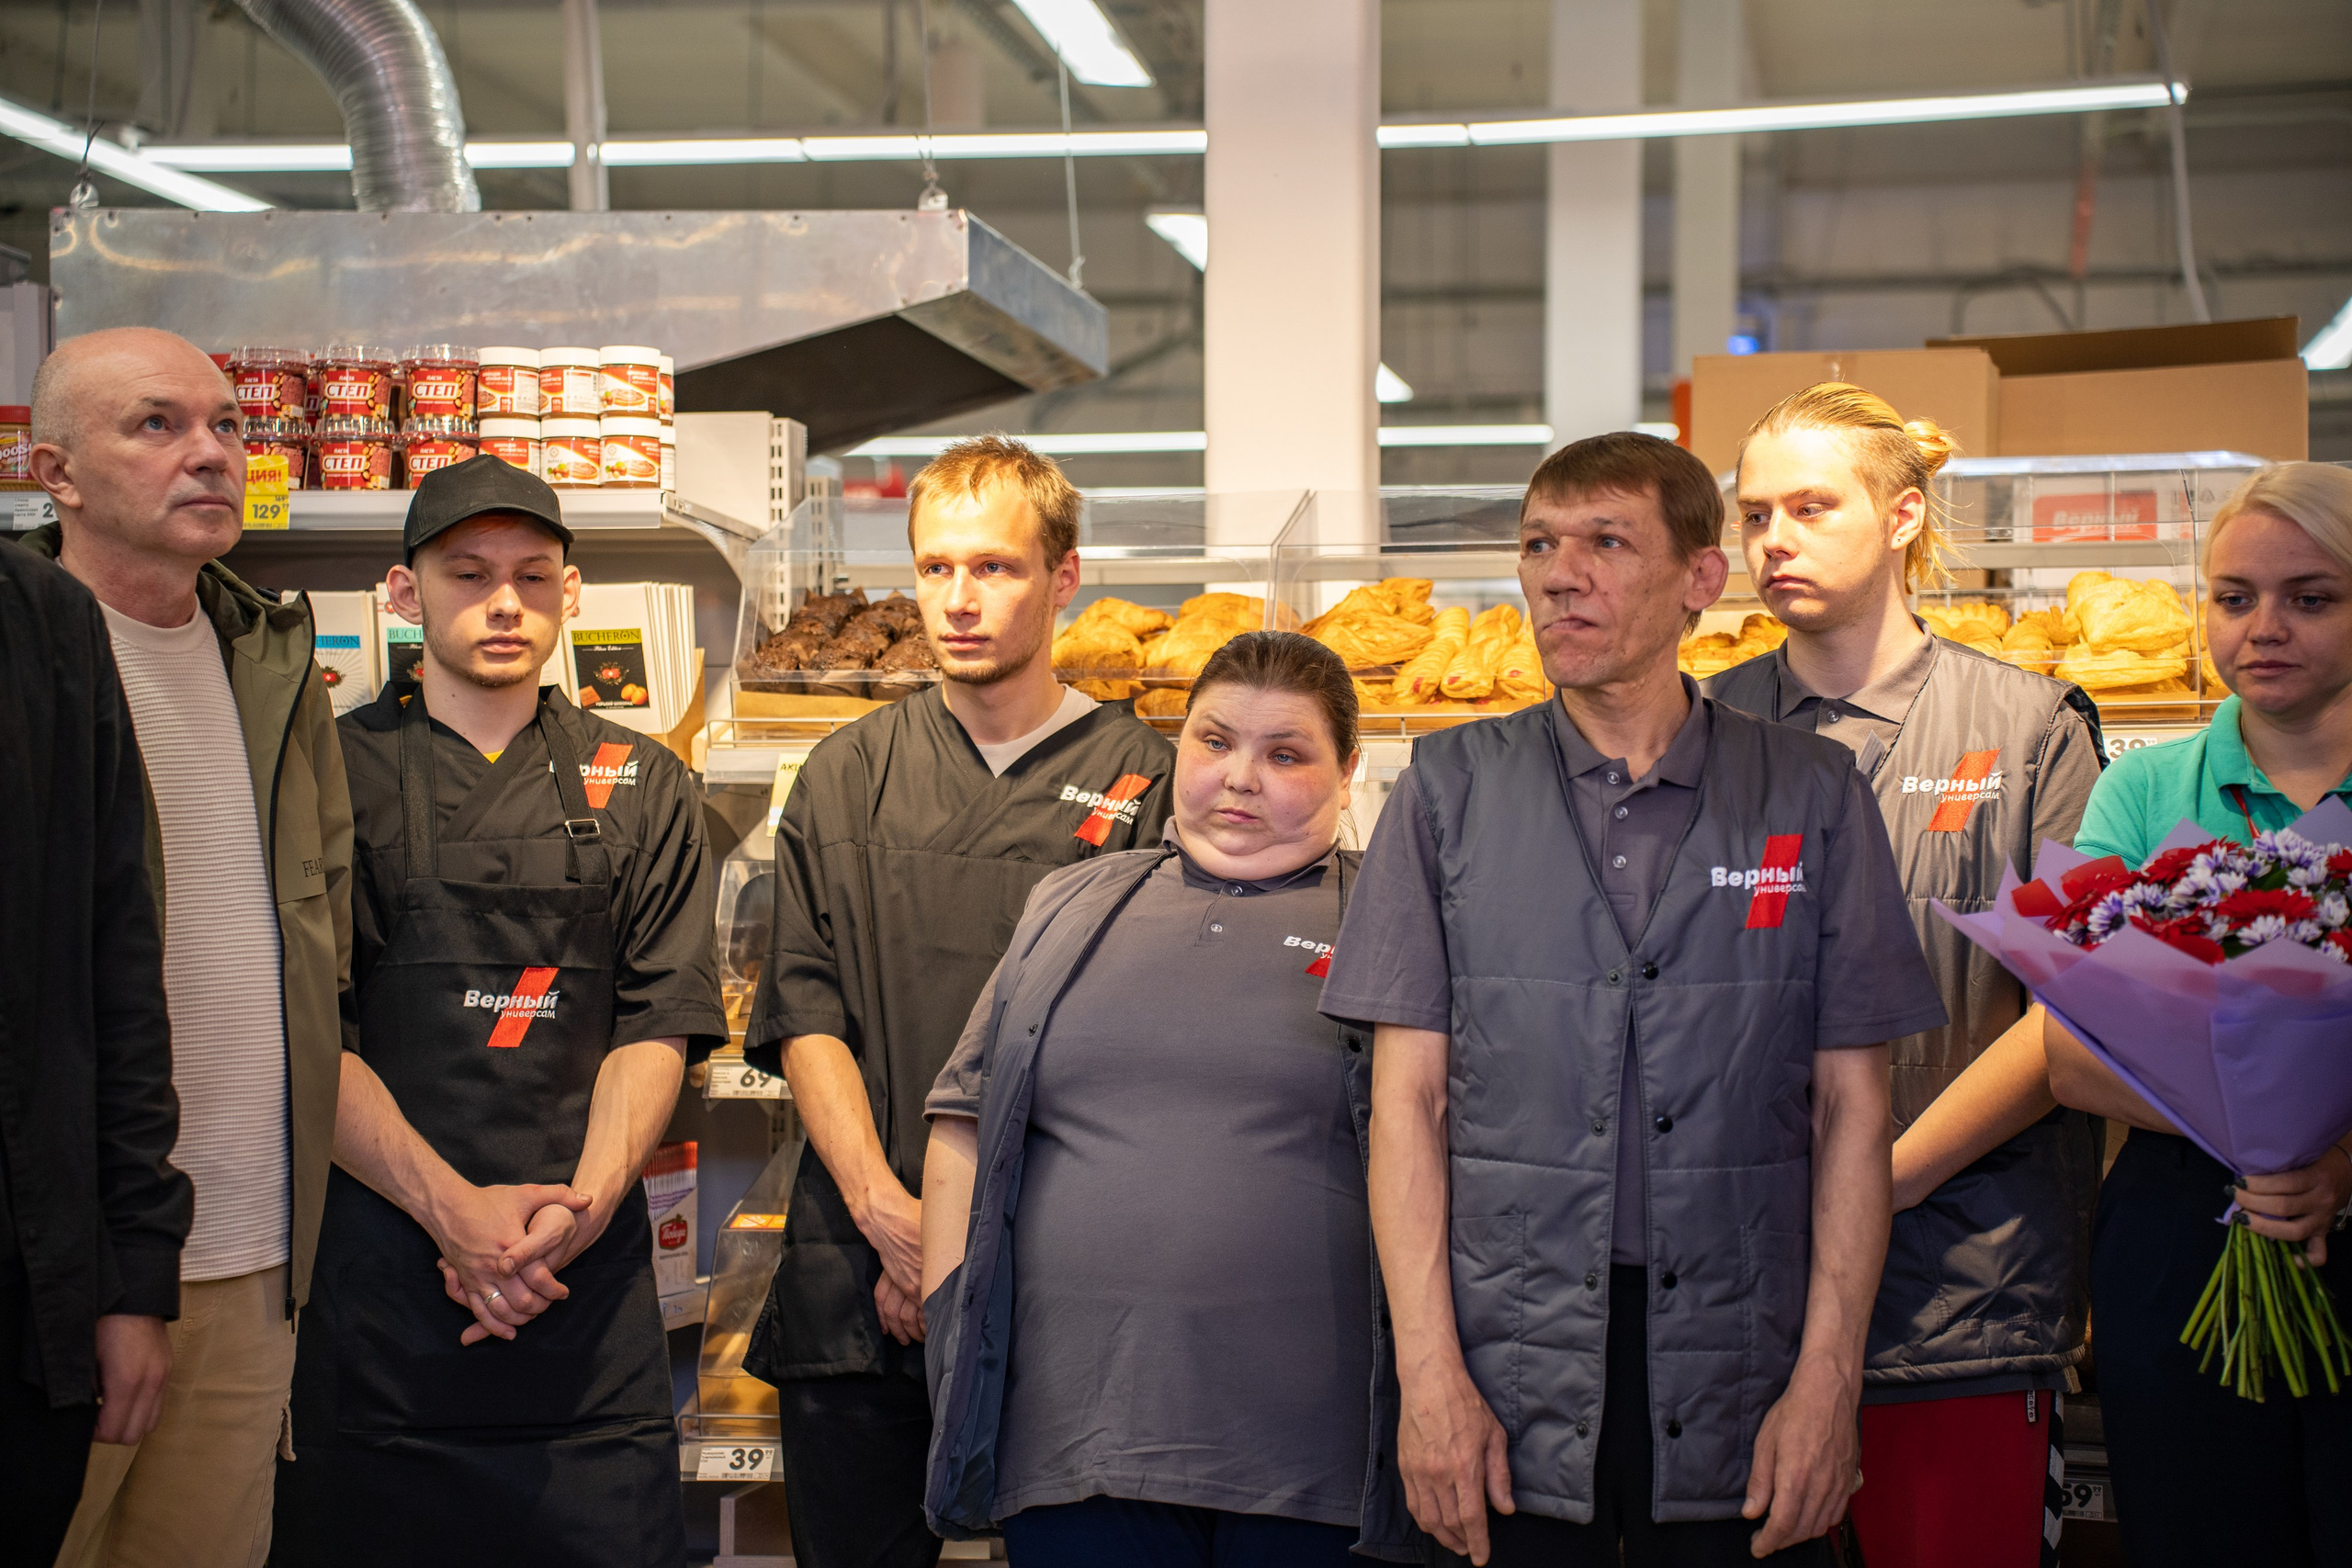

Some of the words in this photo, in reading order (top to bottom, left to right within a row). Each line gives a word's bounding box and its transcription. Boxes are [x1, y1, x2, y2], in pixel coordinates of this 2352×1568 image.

[236, 387, 273, 400] СТЕП
[326, 385, 368, 397] СТЕП
[414, 384, 456, 397] СТЕП
[323, 457, 363, 469] СТЕП
[411, 457, 448, 469] СТЕП
[253, 503, 280, 519] 129
[549, 760, 639, 777] рный
[583, 777, 637, 786] универсам
[1902, 771, 2003, 795] Верный
[1940, 792, 2000, 803] универсам
[1753, 884, 1807, 897] универса
[463, 989, 560, 1012] Верный
[500, 1010, 556, 1020] универсам
[740, 1067, 772, 1088] 69
[729, 1449, 764, 1471] 39
